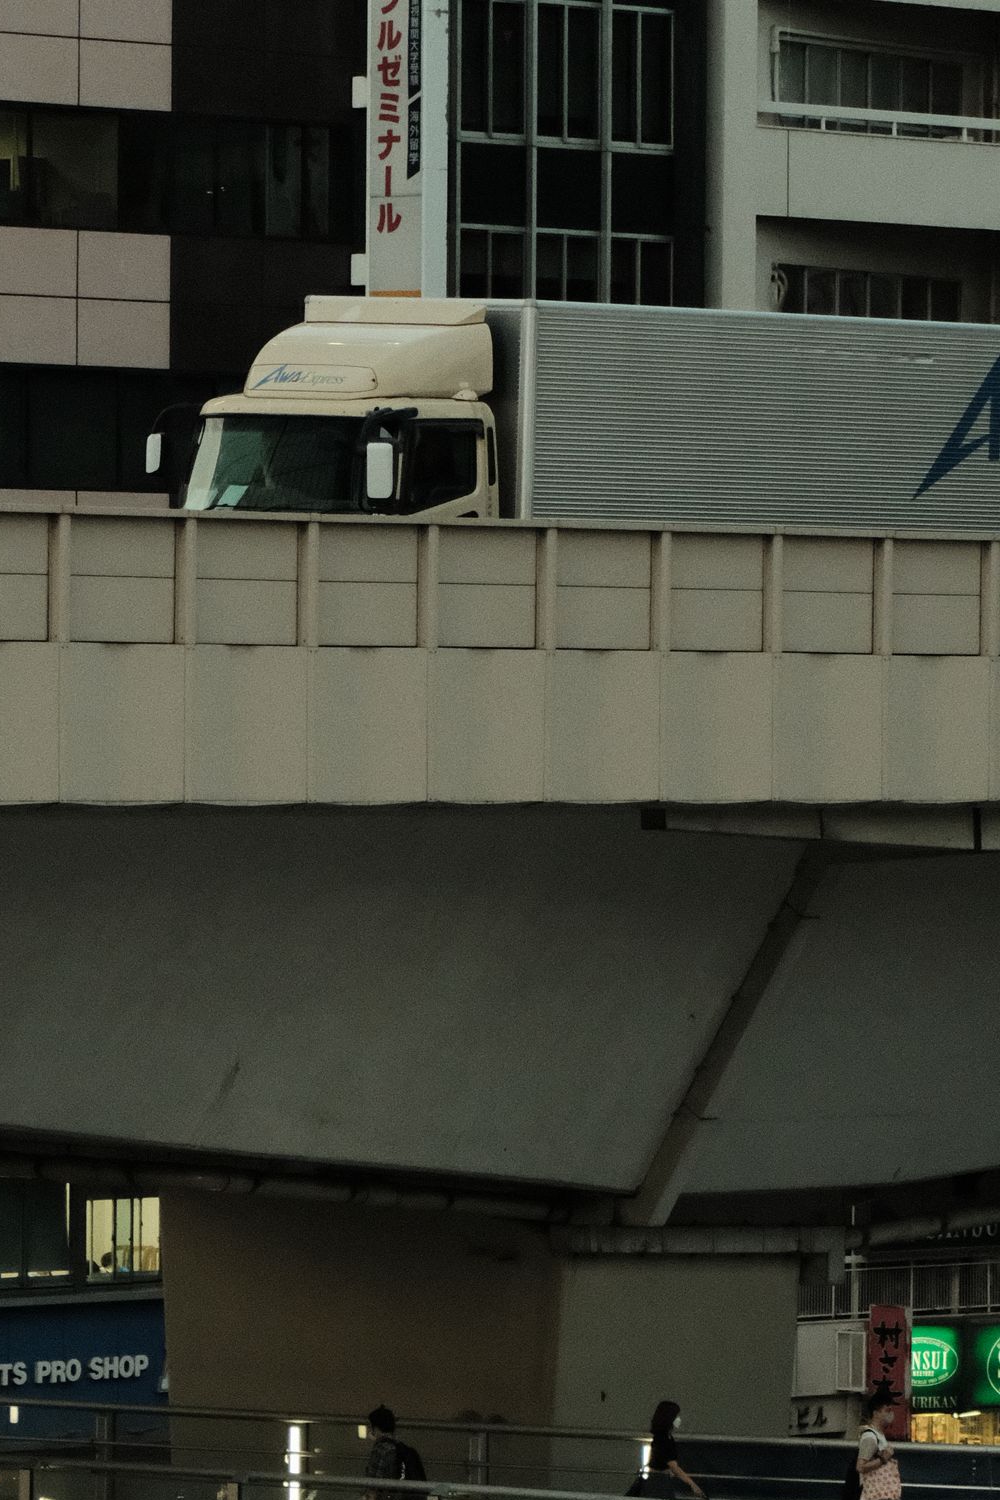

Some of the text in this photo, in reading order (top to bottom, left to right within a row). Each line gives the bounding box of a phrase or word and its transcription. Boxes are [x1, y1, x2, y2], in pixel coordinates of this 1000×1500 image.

[409, 110, 420, 165] 海外留学
[34, 1358, 82, 1384] PRO
[89, 1354, 150, 1381] SHOP
